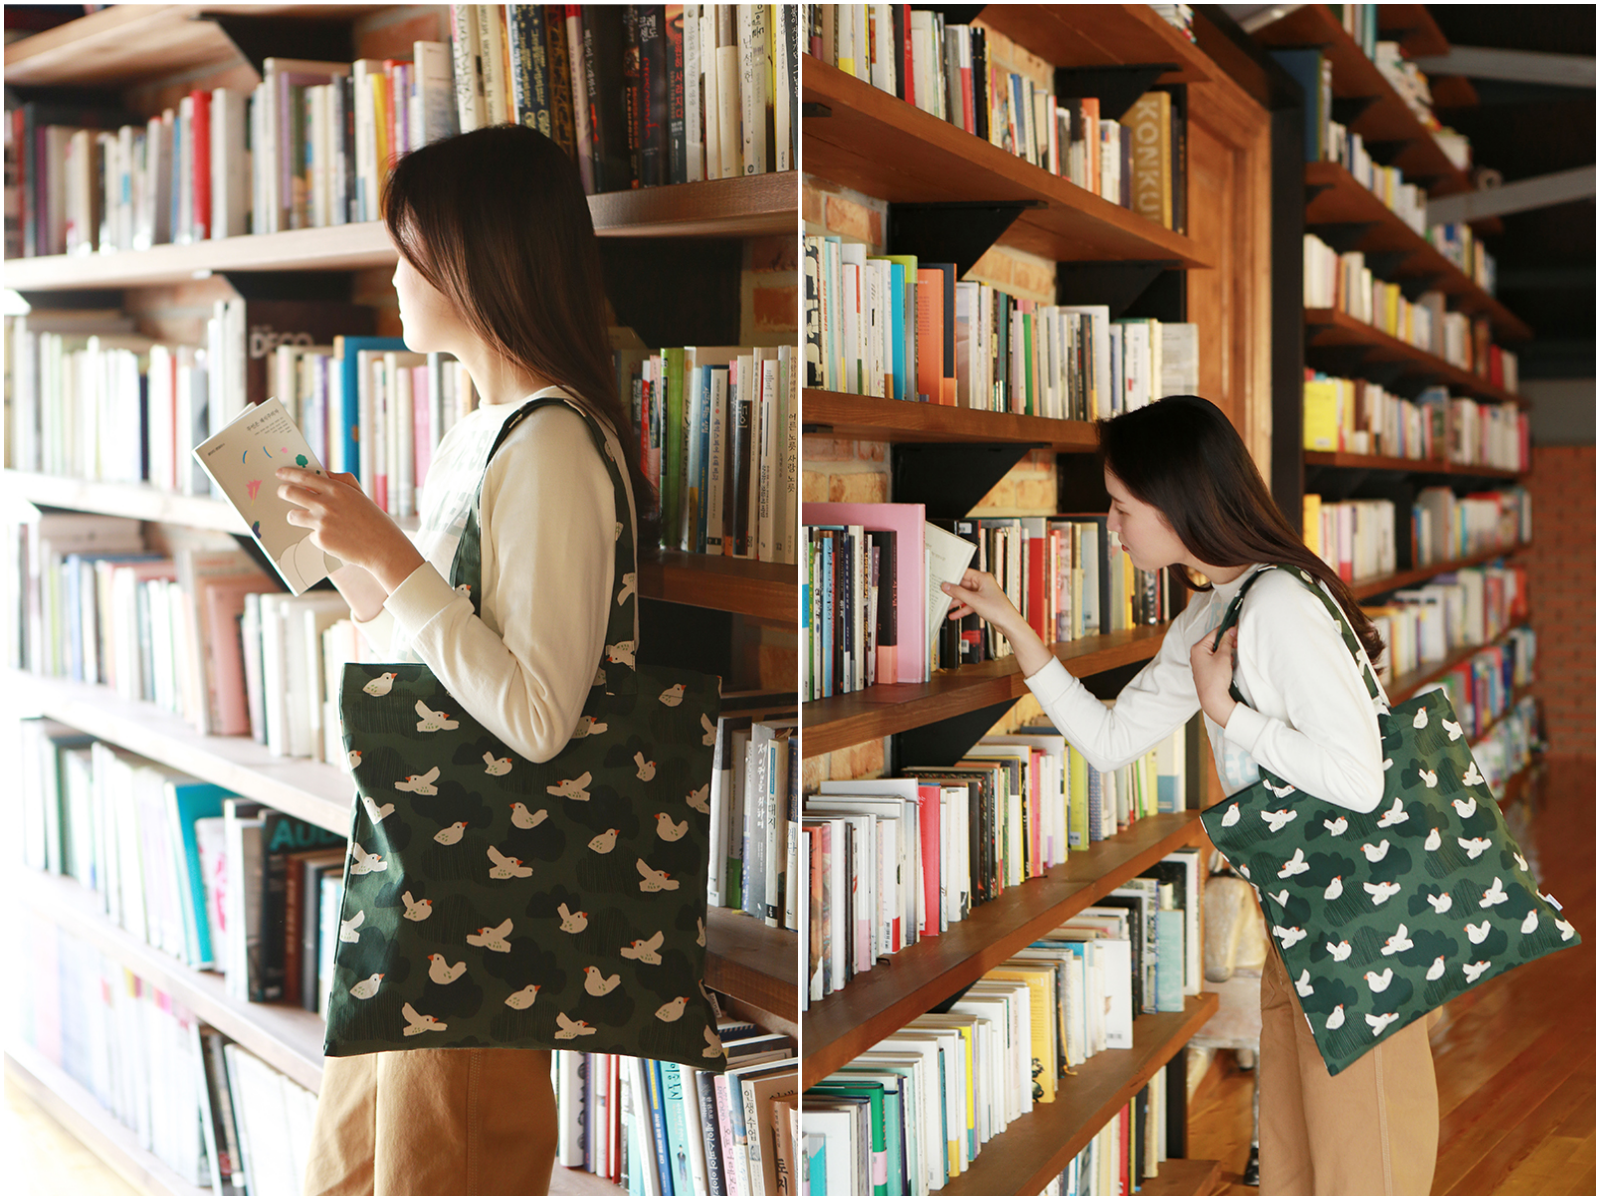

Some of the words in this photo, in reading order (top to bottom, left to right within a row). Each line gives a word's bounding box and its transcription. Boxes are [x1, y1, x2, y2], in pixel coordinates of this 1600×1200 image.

[1136, 100, 1160, 219] KONKU
[788, 413, 797, 432] 어른
[788, 433, 797, 452] 노릇
[767, 804, 776, 830] 대지
[744, 1090, 755, 1114] 인생
[746, 1117, 757, 1142] 수업
[777, 1157, 789, 1196] 토지
